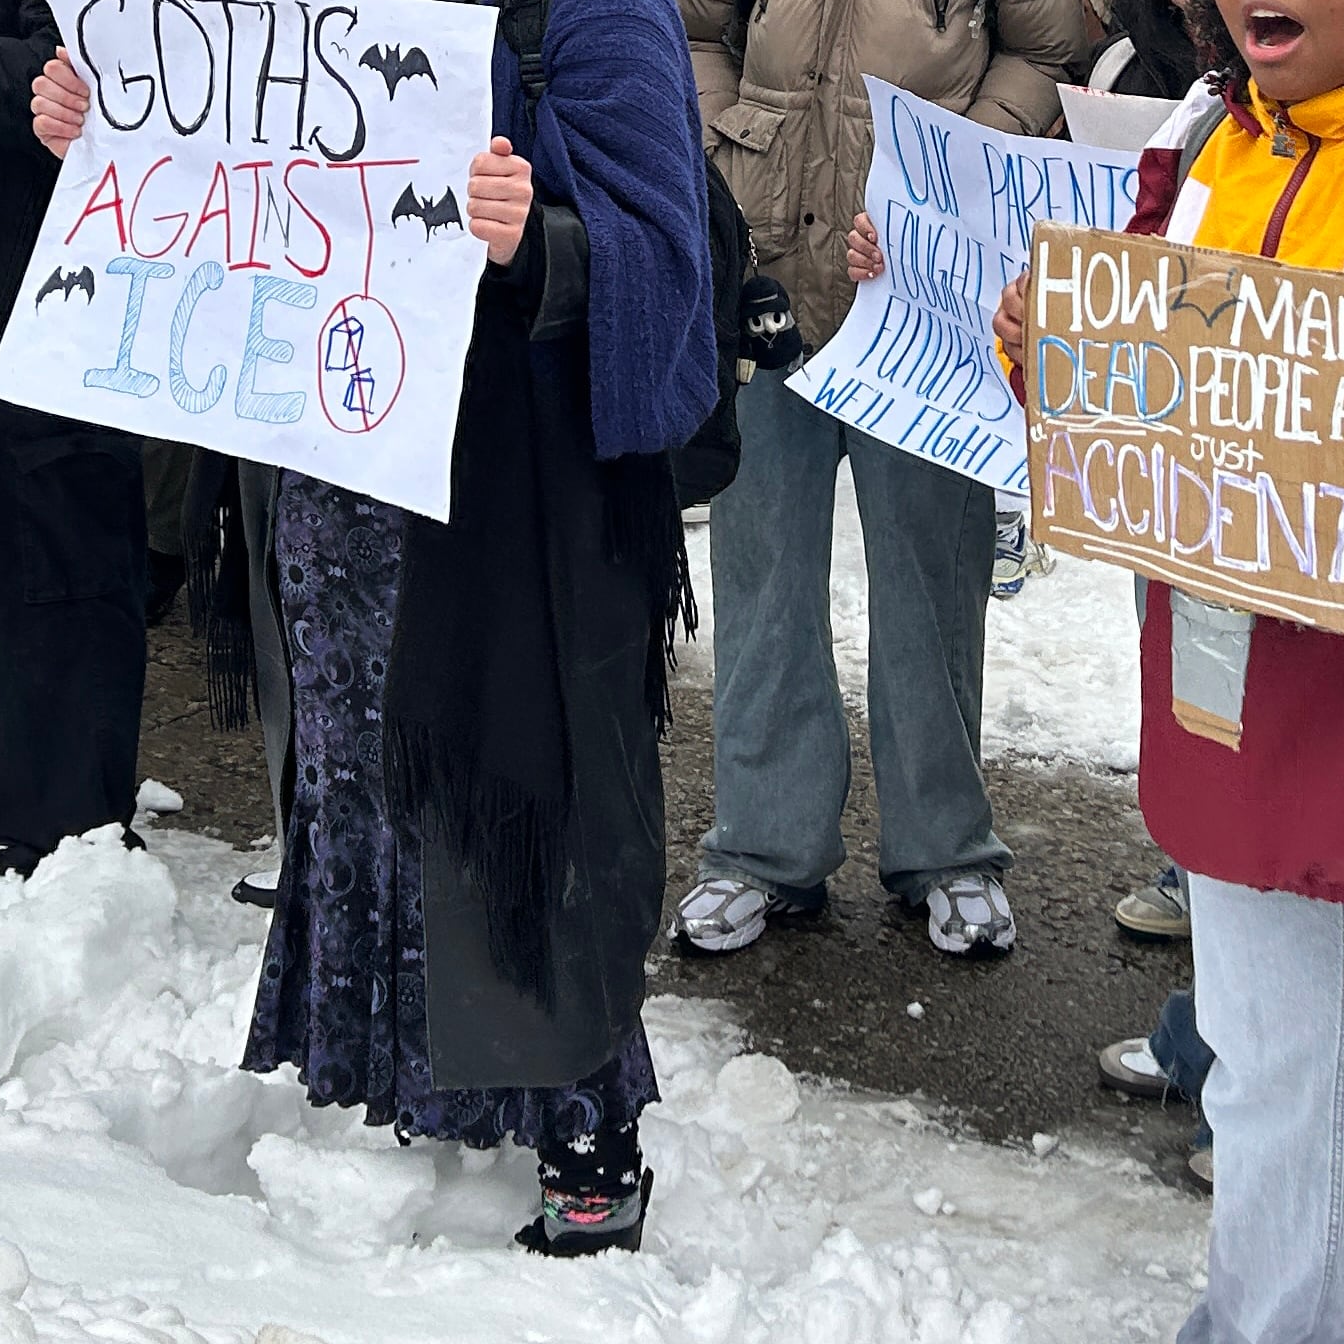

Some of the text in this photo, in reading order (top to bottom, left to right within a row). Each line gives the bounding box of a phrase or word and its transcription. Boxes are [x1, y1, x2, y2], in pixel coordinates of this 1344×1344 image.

[64, 156, 420, 301] AGAINST
[886, 199, 985, 335] FOUGHT
[1037, 240, 1170, 332] HOW
[83, 256, 319, 424] ICE
[856, 294, 1013, 422] FUTURES
[1037, 334, 1185, 424] DEAD
[1189, 346, 1322, 445] PEOPLE
[898, 404, 1013, 476] FIGHT
